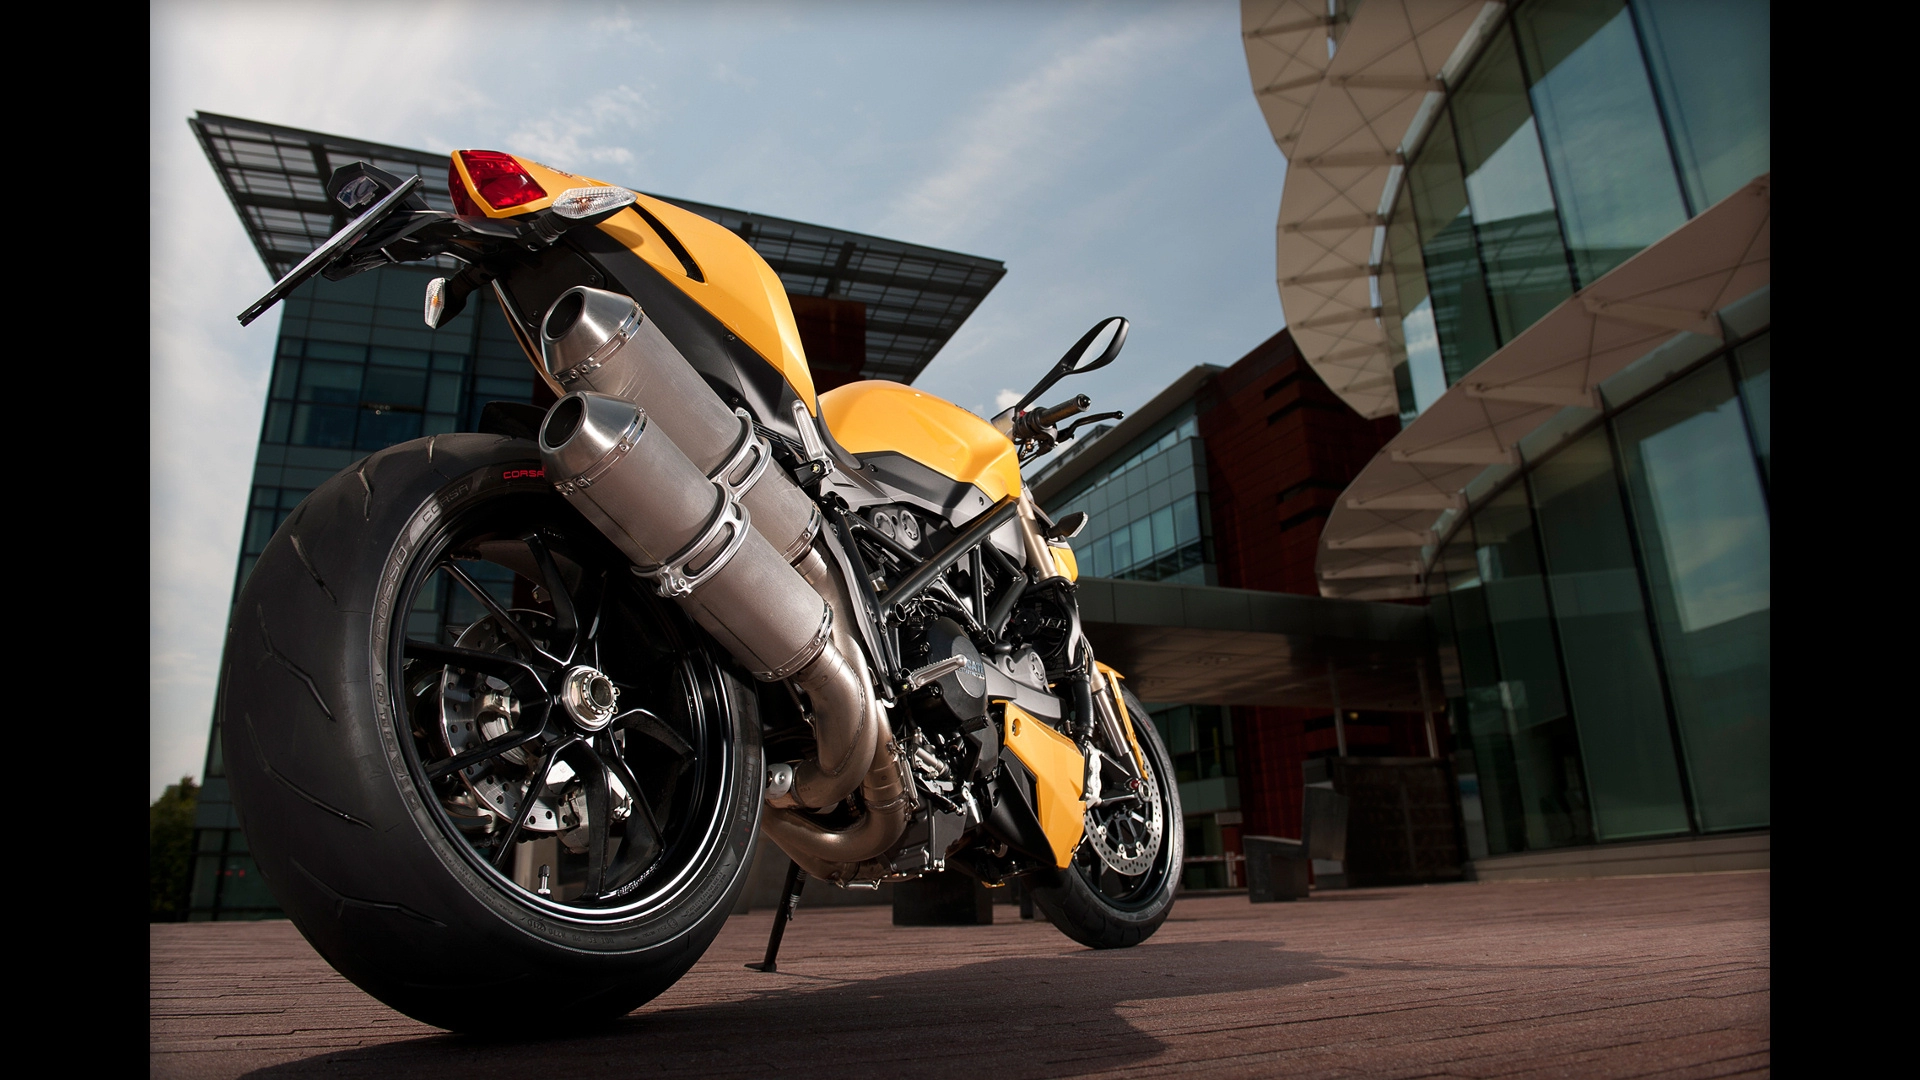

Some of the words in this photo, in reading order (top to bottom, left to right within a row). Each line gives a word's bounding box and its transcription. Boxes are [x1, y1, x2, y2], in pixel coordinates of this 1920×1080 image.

[503, 469, 545, 480] CORSA
[374, 545, 408, 642] ROSSO
[422, 483, 470, 523] CORSA
